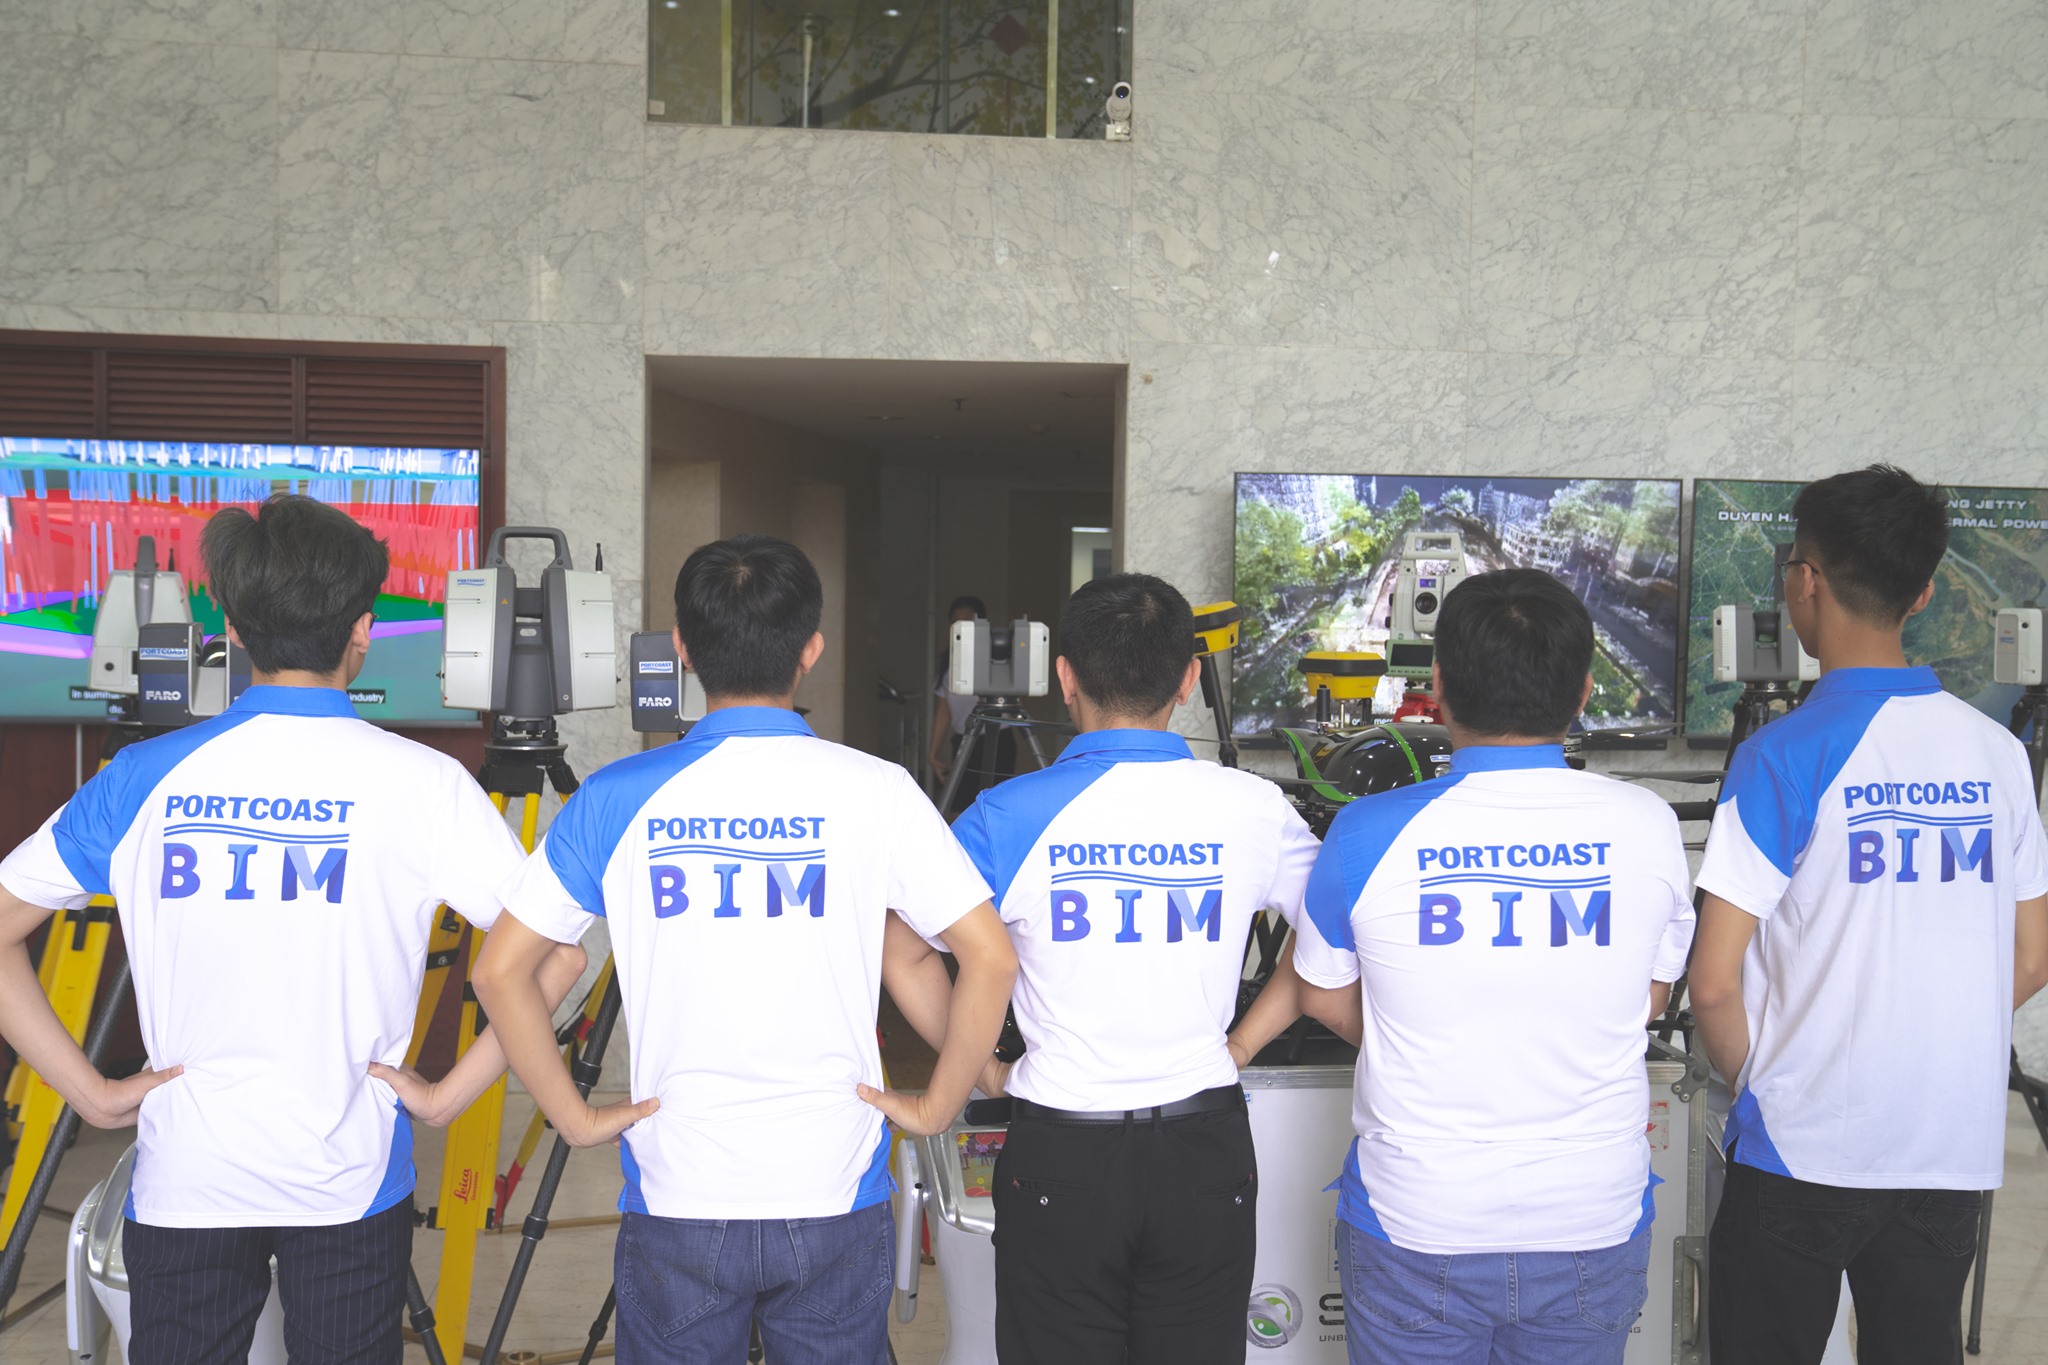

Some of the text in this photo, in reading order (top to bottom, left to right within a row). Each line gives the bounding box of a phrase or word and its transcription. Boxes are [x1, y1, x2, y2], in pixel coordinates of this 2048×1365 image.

[1718, 511, 1773, 522] DUYEN
[1975, 499, 2027, 510] JETTY
[145, 690, 182, 701] FARO
[638, 696, 672, 707] FARO
[165, 794, 355, 823] PORTCOAST
[1843, 781, 1992, 809] PORTCOAST
[648, 816, 826, 841] PORTCOAST
[1048, 843, 1224, 867] PORTCOAST
[1417, 842, 1611, 871] PORTCOAST
[1848, 828, 1994, 884] BIM
[161, 842, 348, 904] BIM
[649, 863, 826, 919] BIM
[1050, 888, 1223, 943] BIM
[1418, 890, 1611, 947] BIM
[453, 1168, 472, 1204] Leica
